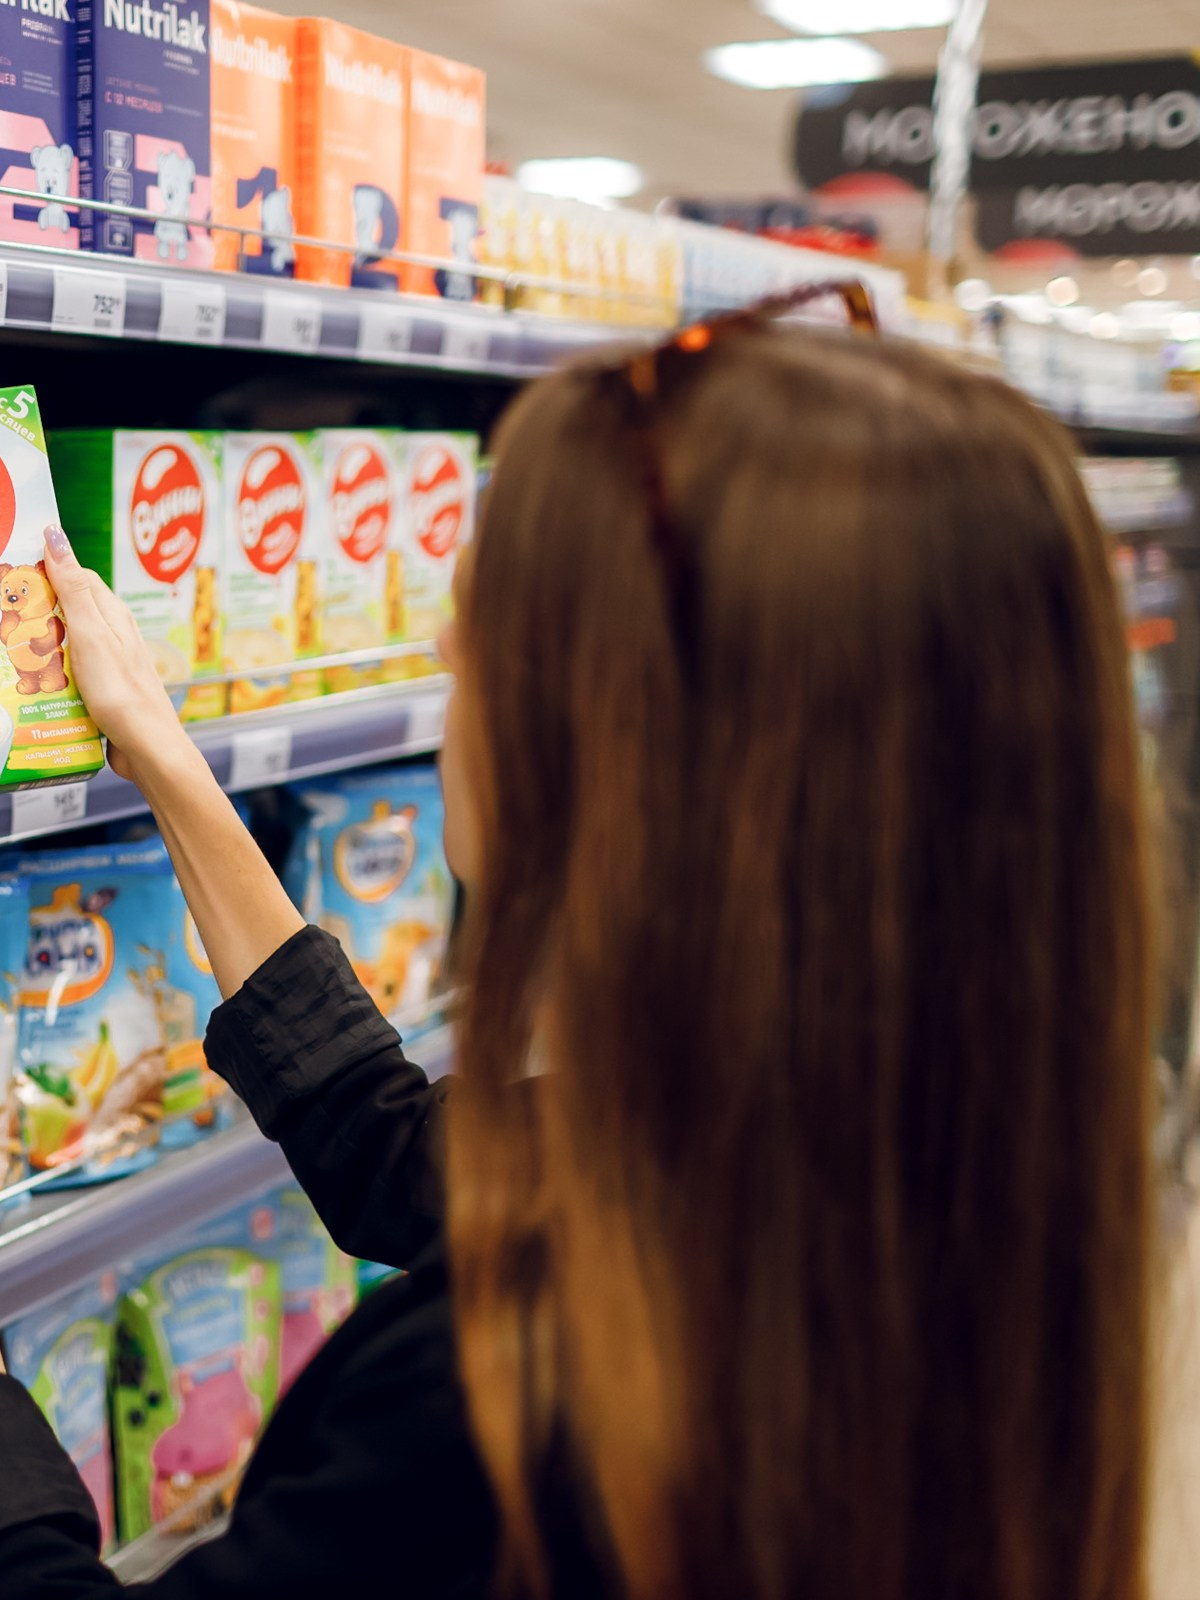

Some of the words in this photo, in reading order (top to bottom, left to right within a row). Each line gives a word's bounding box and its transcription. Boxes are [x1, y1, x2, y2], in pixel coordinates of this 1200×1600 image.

[104, 0, 207, 54] Nutrilak
[841, 89, 1200, 166] МООЖЕНО
[6, 390, 36, 420] 5
[21, 705, 40, 715] 100%
[41, 725, 88, 739] ВИТАМИНОВ
